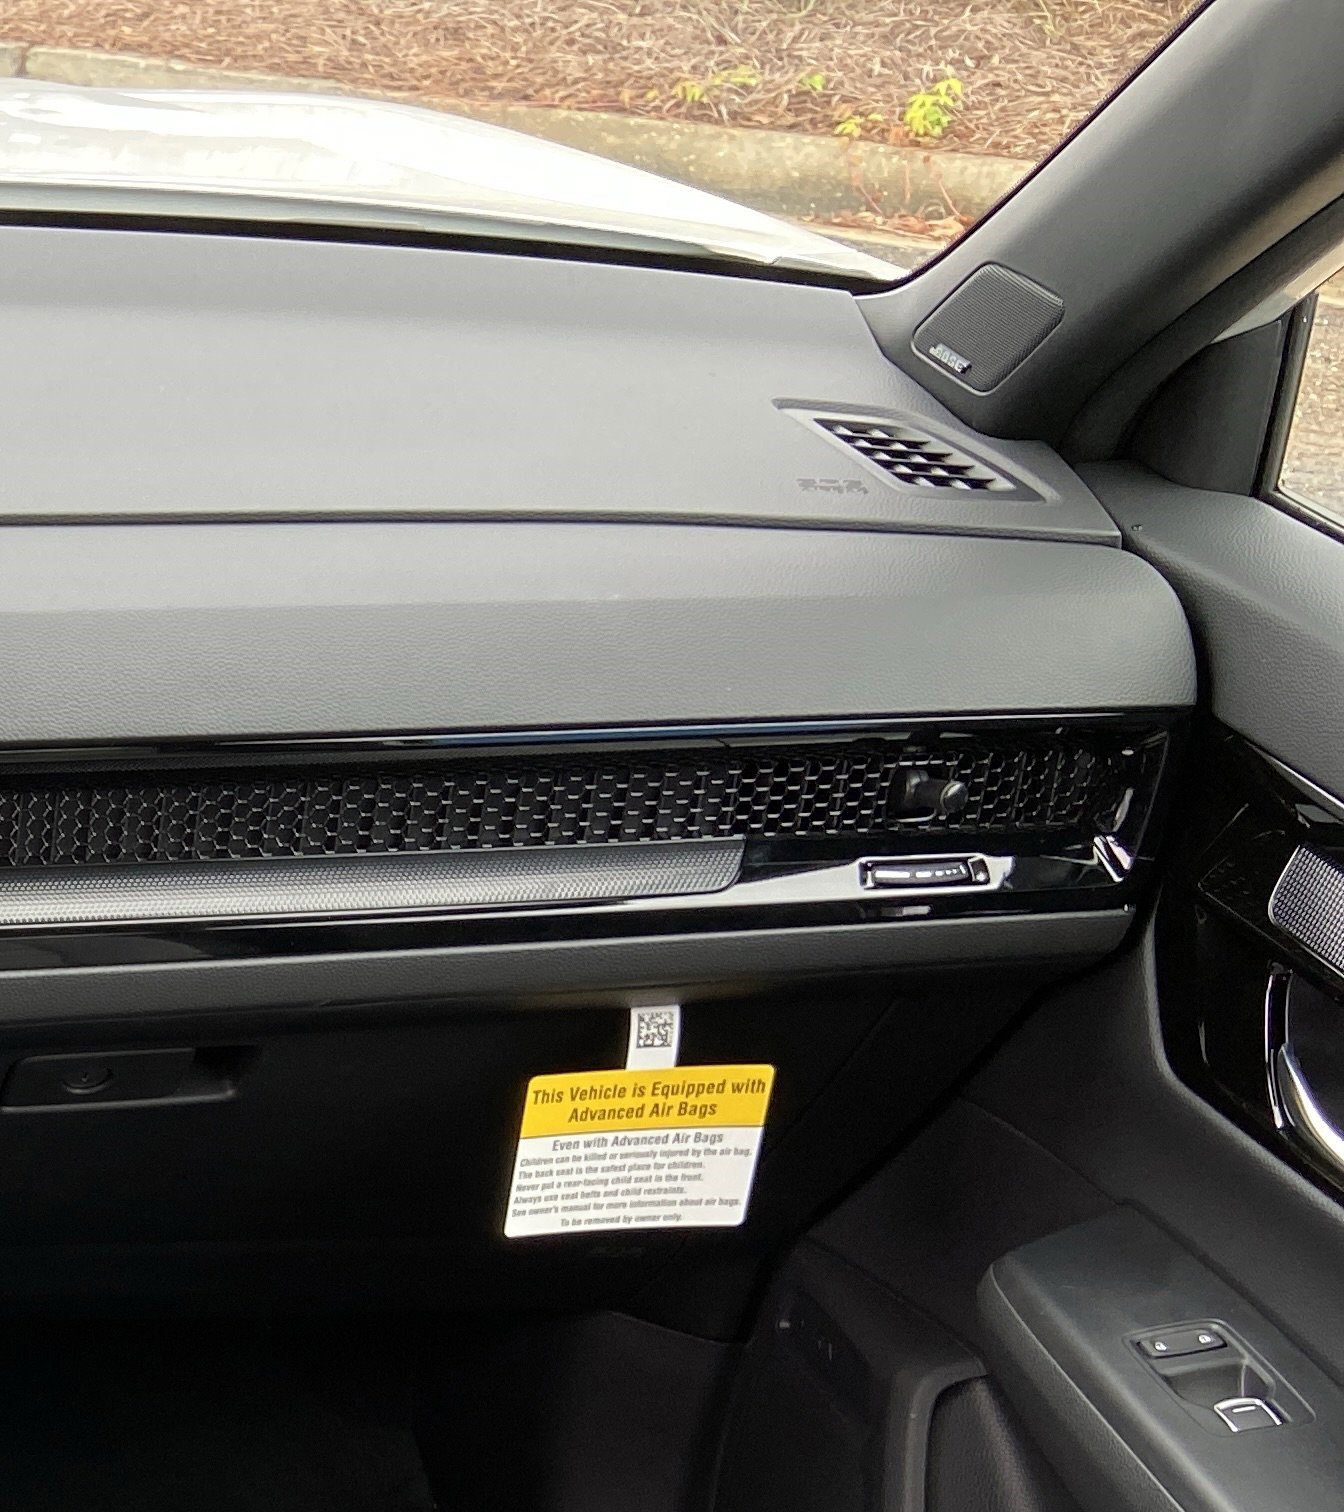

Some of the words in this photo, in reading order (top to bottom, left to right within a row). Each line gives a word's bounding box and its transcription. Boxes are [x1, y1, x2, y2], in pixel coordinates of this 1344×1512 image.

[532, 1088, 564, 1106] This
[569, 1083, 627, 1103] Vehicle
[633, 1081, 646, 1099] is
[651, 1078, 726, 1102] Equipped
[731, 1077, 767, 1096] with
[568, 1103, 645, 1124] Advanced
[649, 1102, 674, 1119] Air
[677, 1101, 719, 1121] Bags
[552, 1139, 581, 1152] Even
[583, 1137, 609, 1149] with
[611, 1133, 670, 1148] Advanced
[672, 1132, 691, 1145] Air
[693, 1131, 725, 1146] Bags
[704, 1147, 717, 1157] the
[719, 1147, 732, 1156] air
